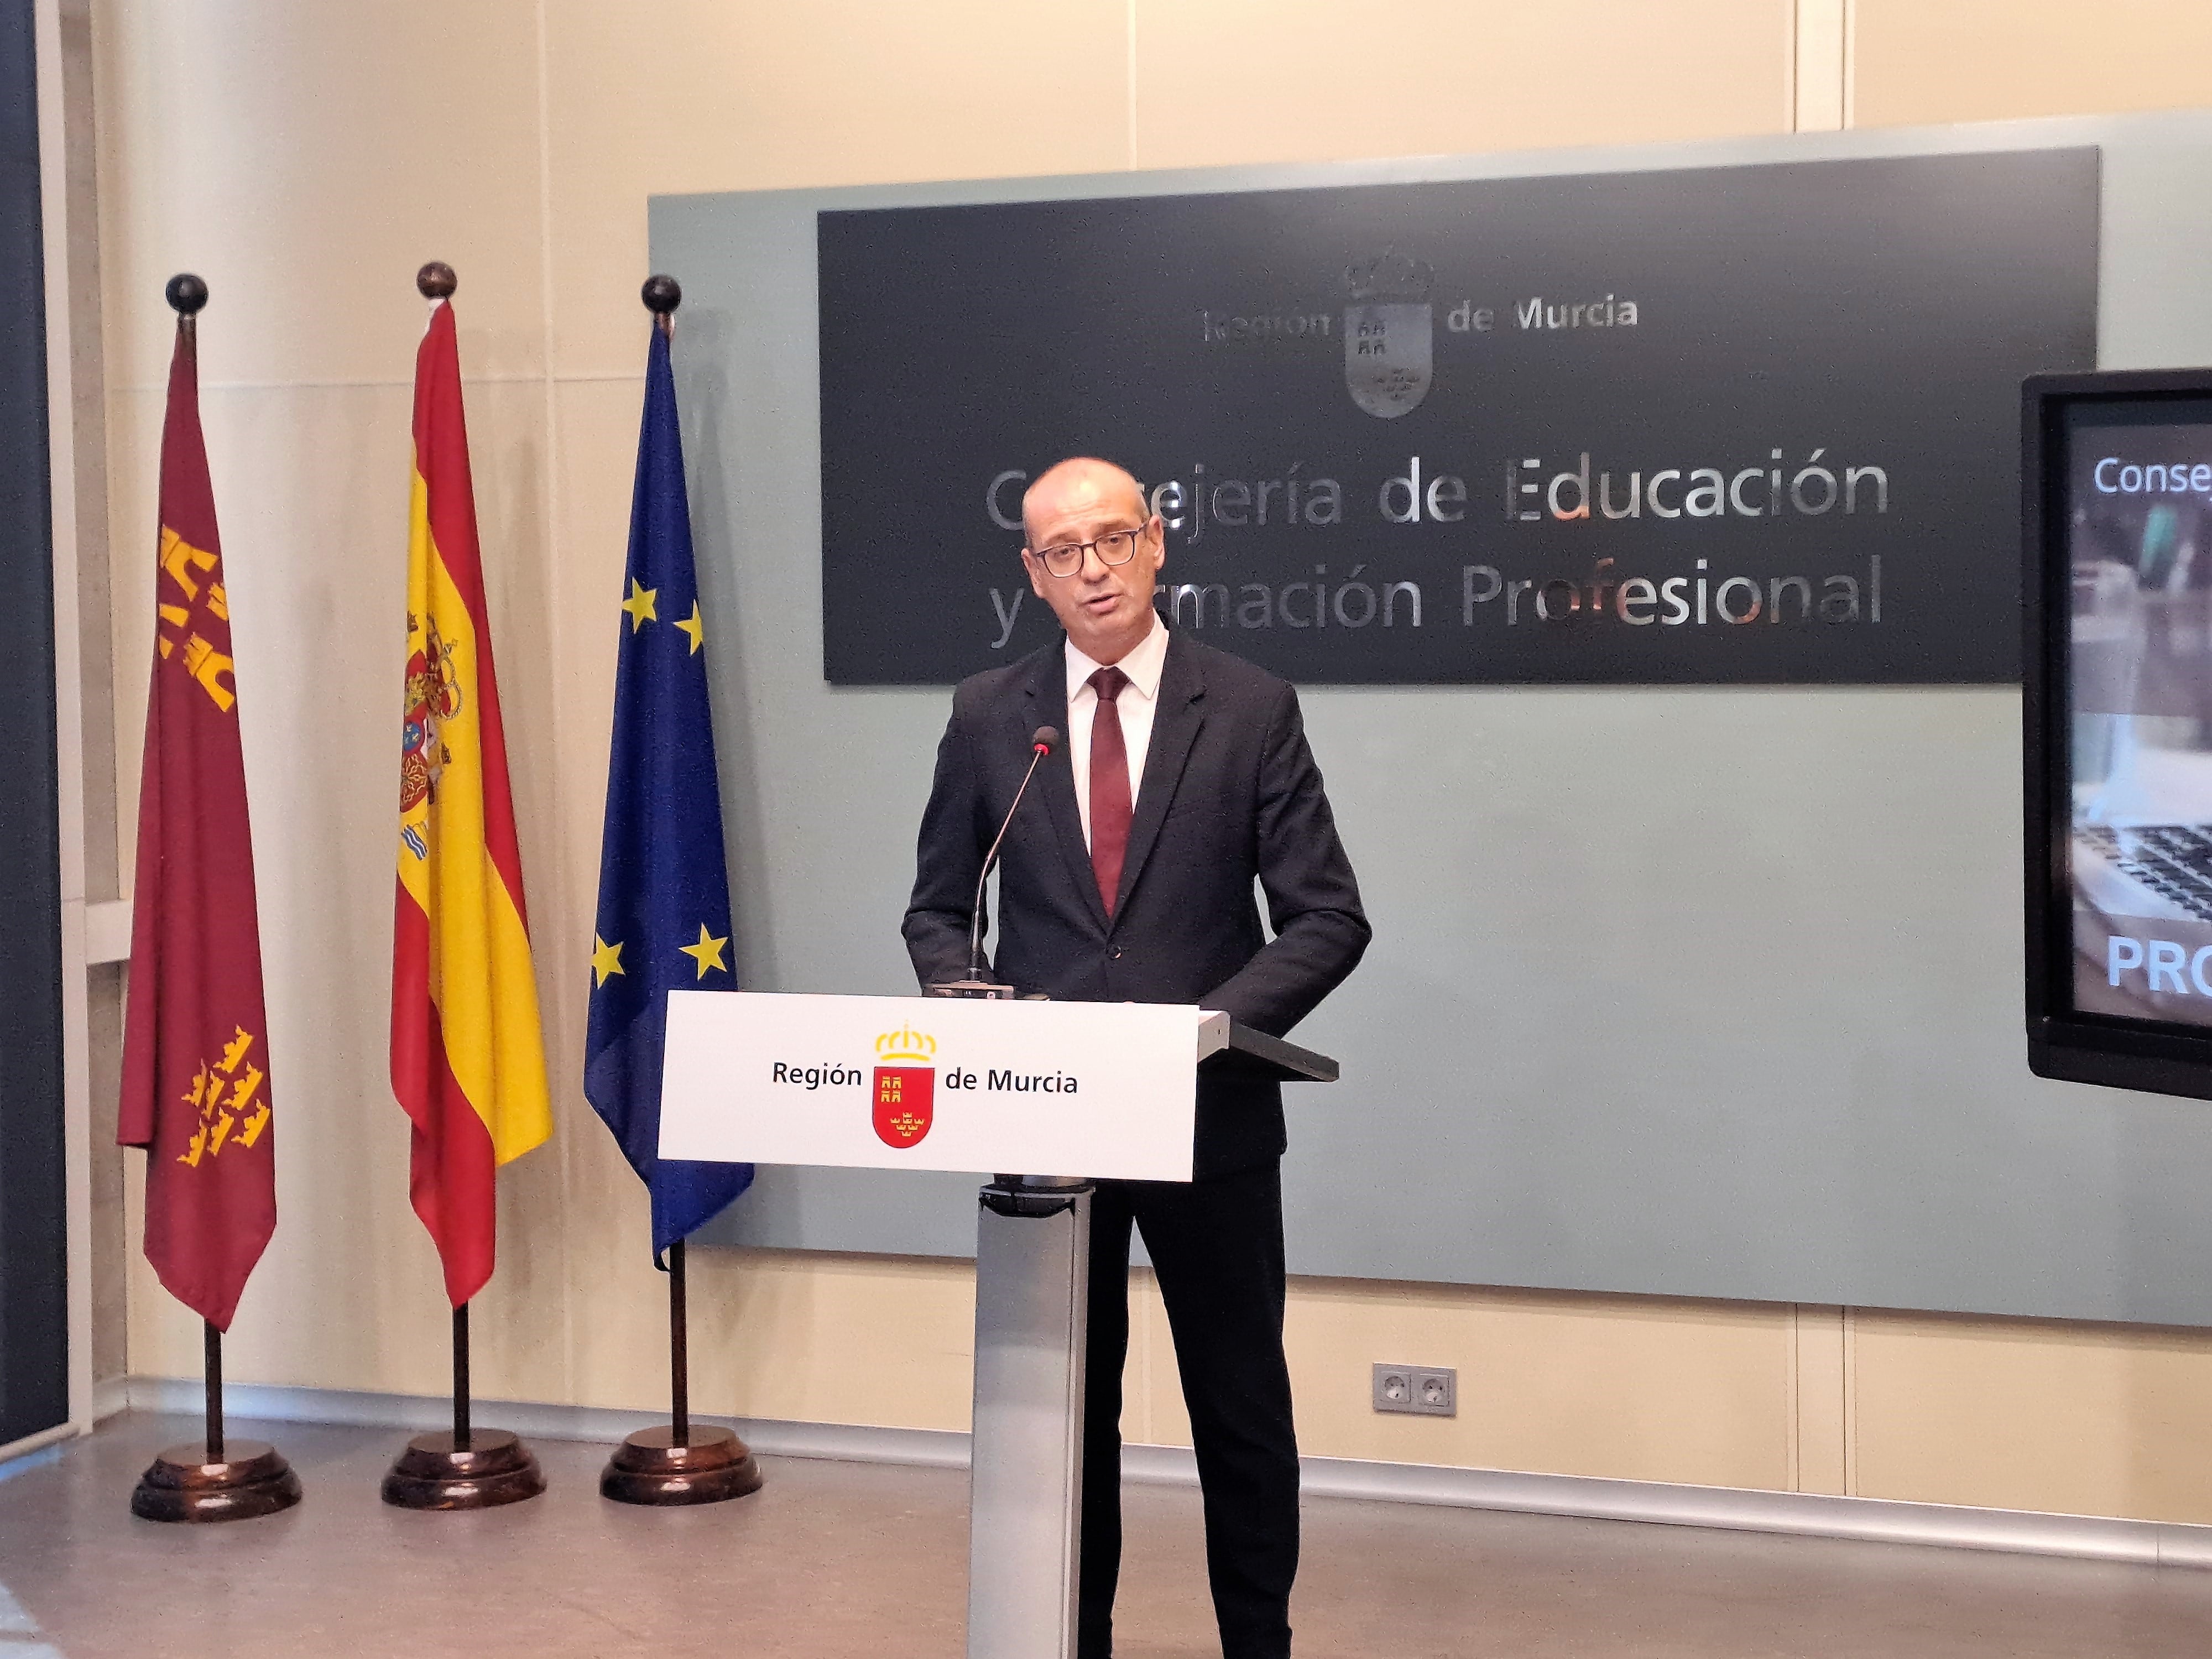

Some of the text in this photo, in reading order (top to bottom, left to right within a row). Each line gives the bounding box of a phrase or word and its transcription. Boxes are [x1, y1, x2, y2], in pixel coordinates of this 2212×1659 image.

[1447, 299, 1494, 332] de
[1515, 293, 1639, 331] Murcia
[986, 447, 1888, 545] Cejería de Educación
[2094, 457, 2212, 503] Conse
[989, 554, 1881, 649] y mación Profesional
[773, 1062, 1078, 1093] Región de Murcia
